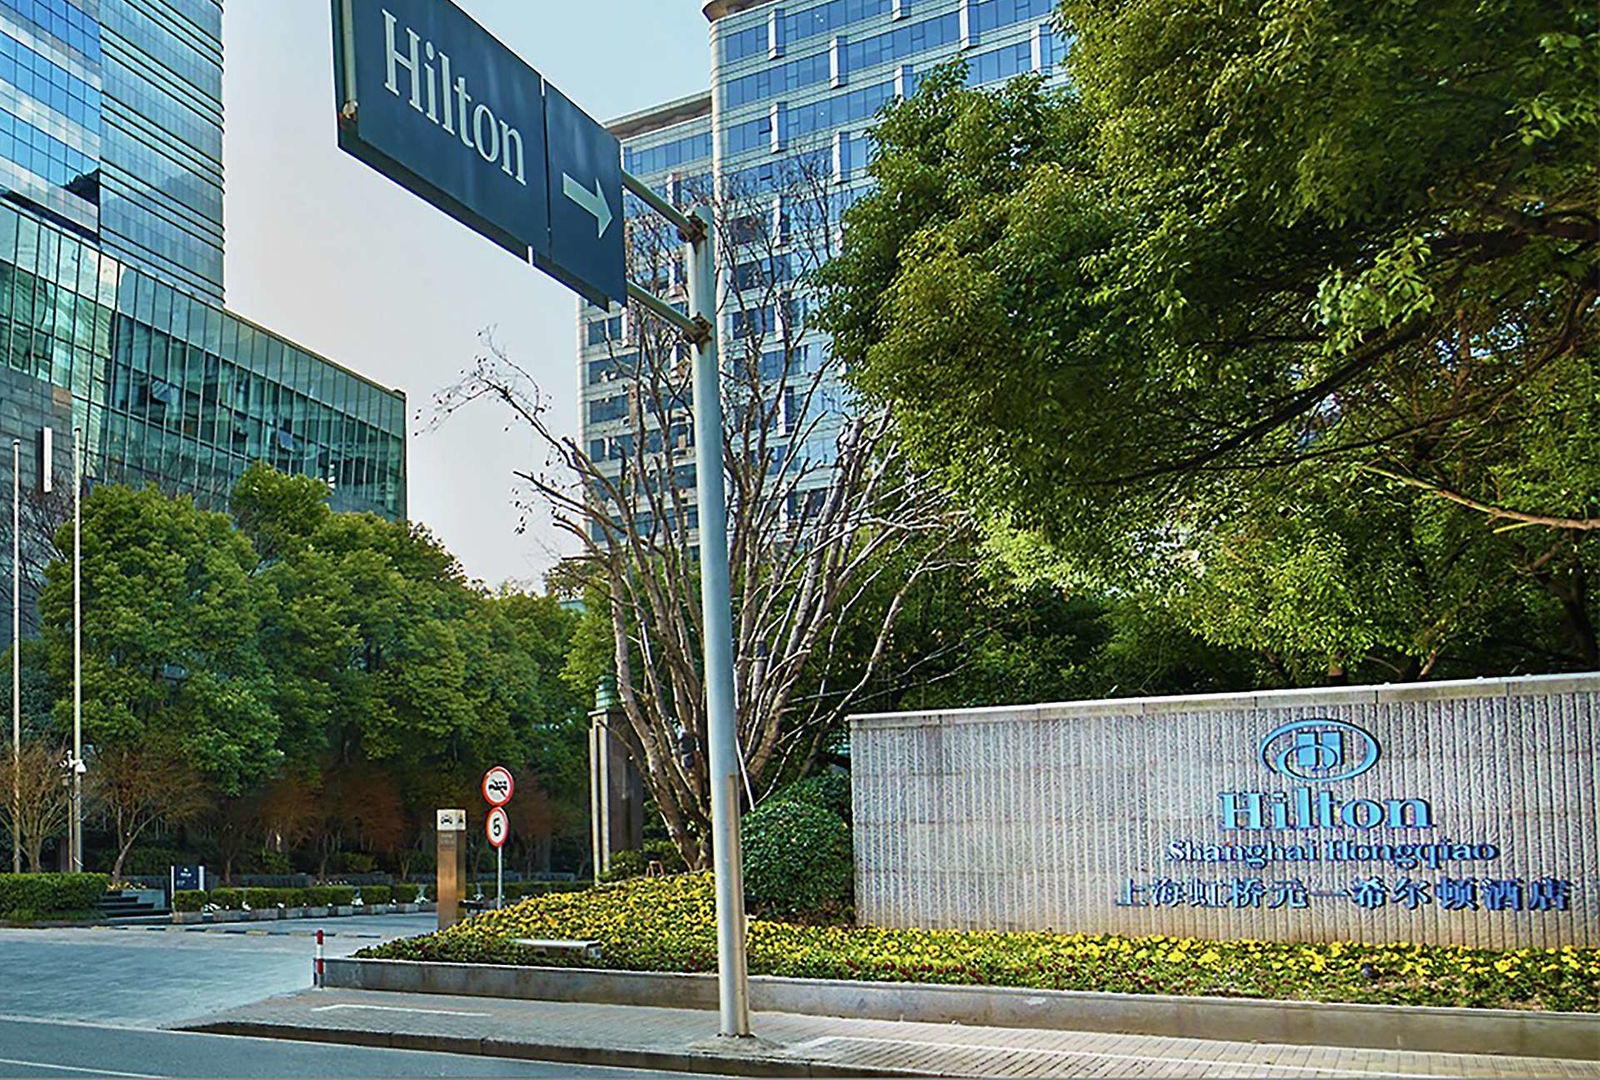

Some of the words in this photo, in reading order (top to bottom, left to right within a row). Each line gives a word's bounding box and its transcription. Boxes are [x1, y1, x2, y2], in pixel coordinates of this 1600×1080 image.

[381, 8, 527, 187] Hilton
[492, 817, 501, 837] 5
[1217, 787, 1437, 833] Hilton
[1166, 839, 1318, 869] Shanghai
[1326, 837, 1500, 870] Hongqiao
[1115, 874, 1572, 913] 上海虹桥元一希尔顿酒店
